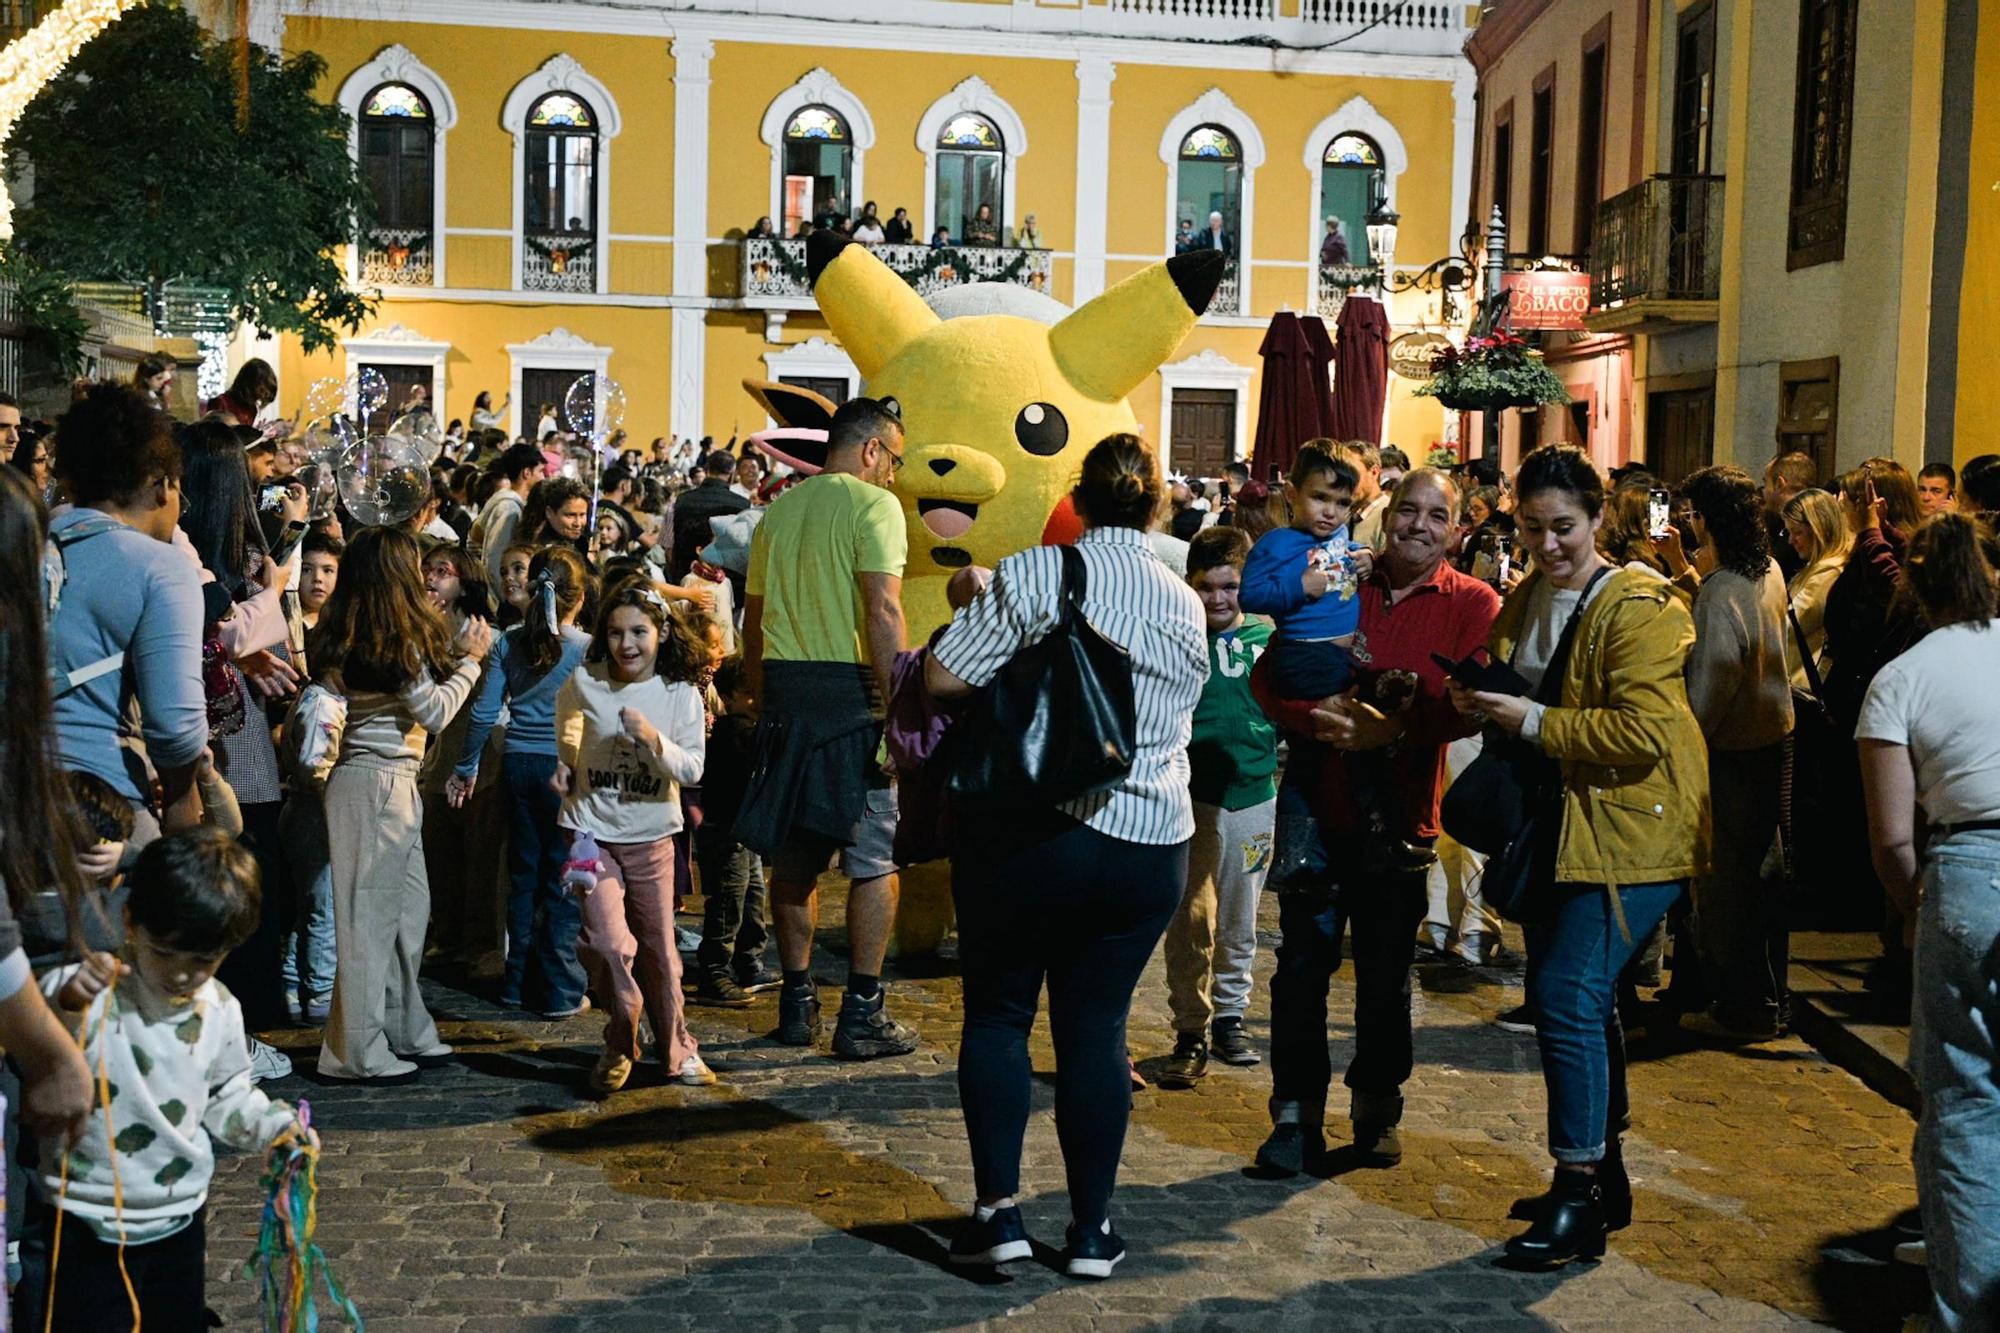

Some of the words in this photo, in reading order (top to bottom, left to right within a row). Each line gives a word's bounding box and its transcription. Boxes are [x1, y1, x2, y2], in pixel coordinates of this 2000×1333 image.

[1533, 295, 1589, 313] BACO
[588, 767, 620, 790] COOL
[623, 774, 662, 797] YOGA
